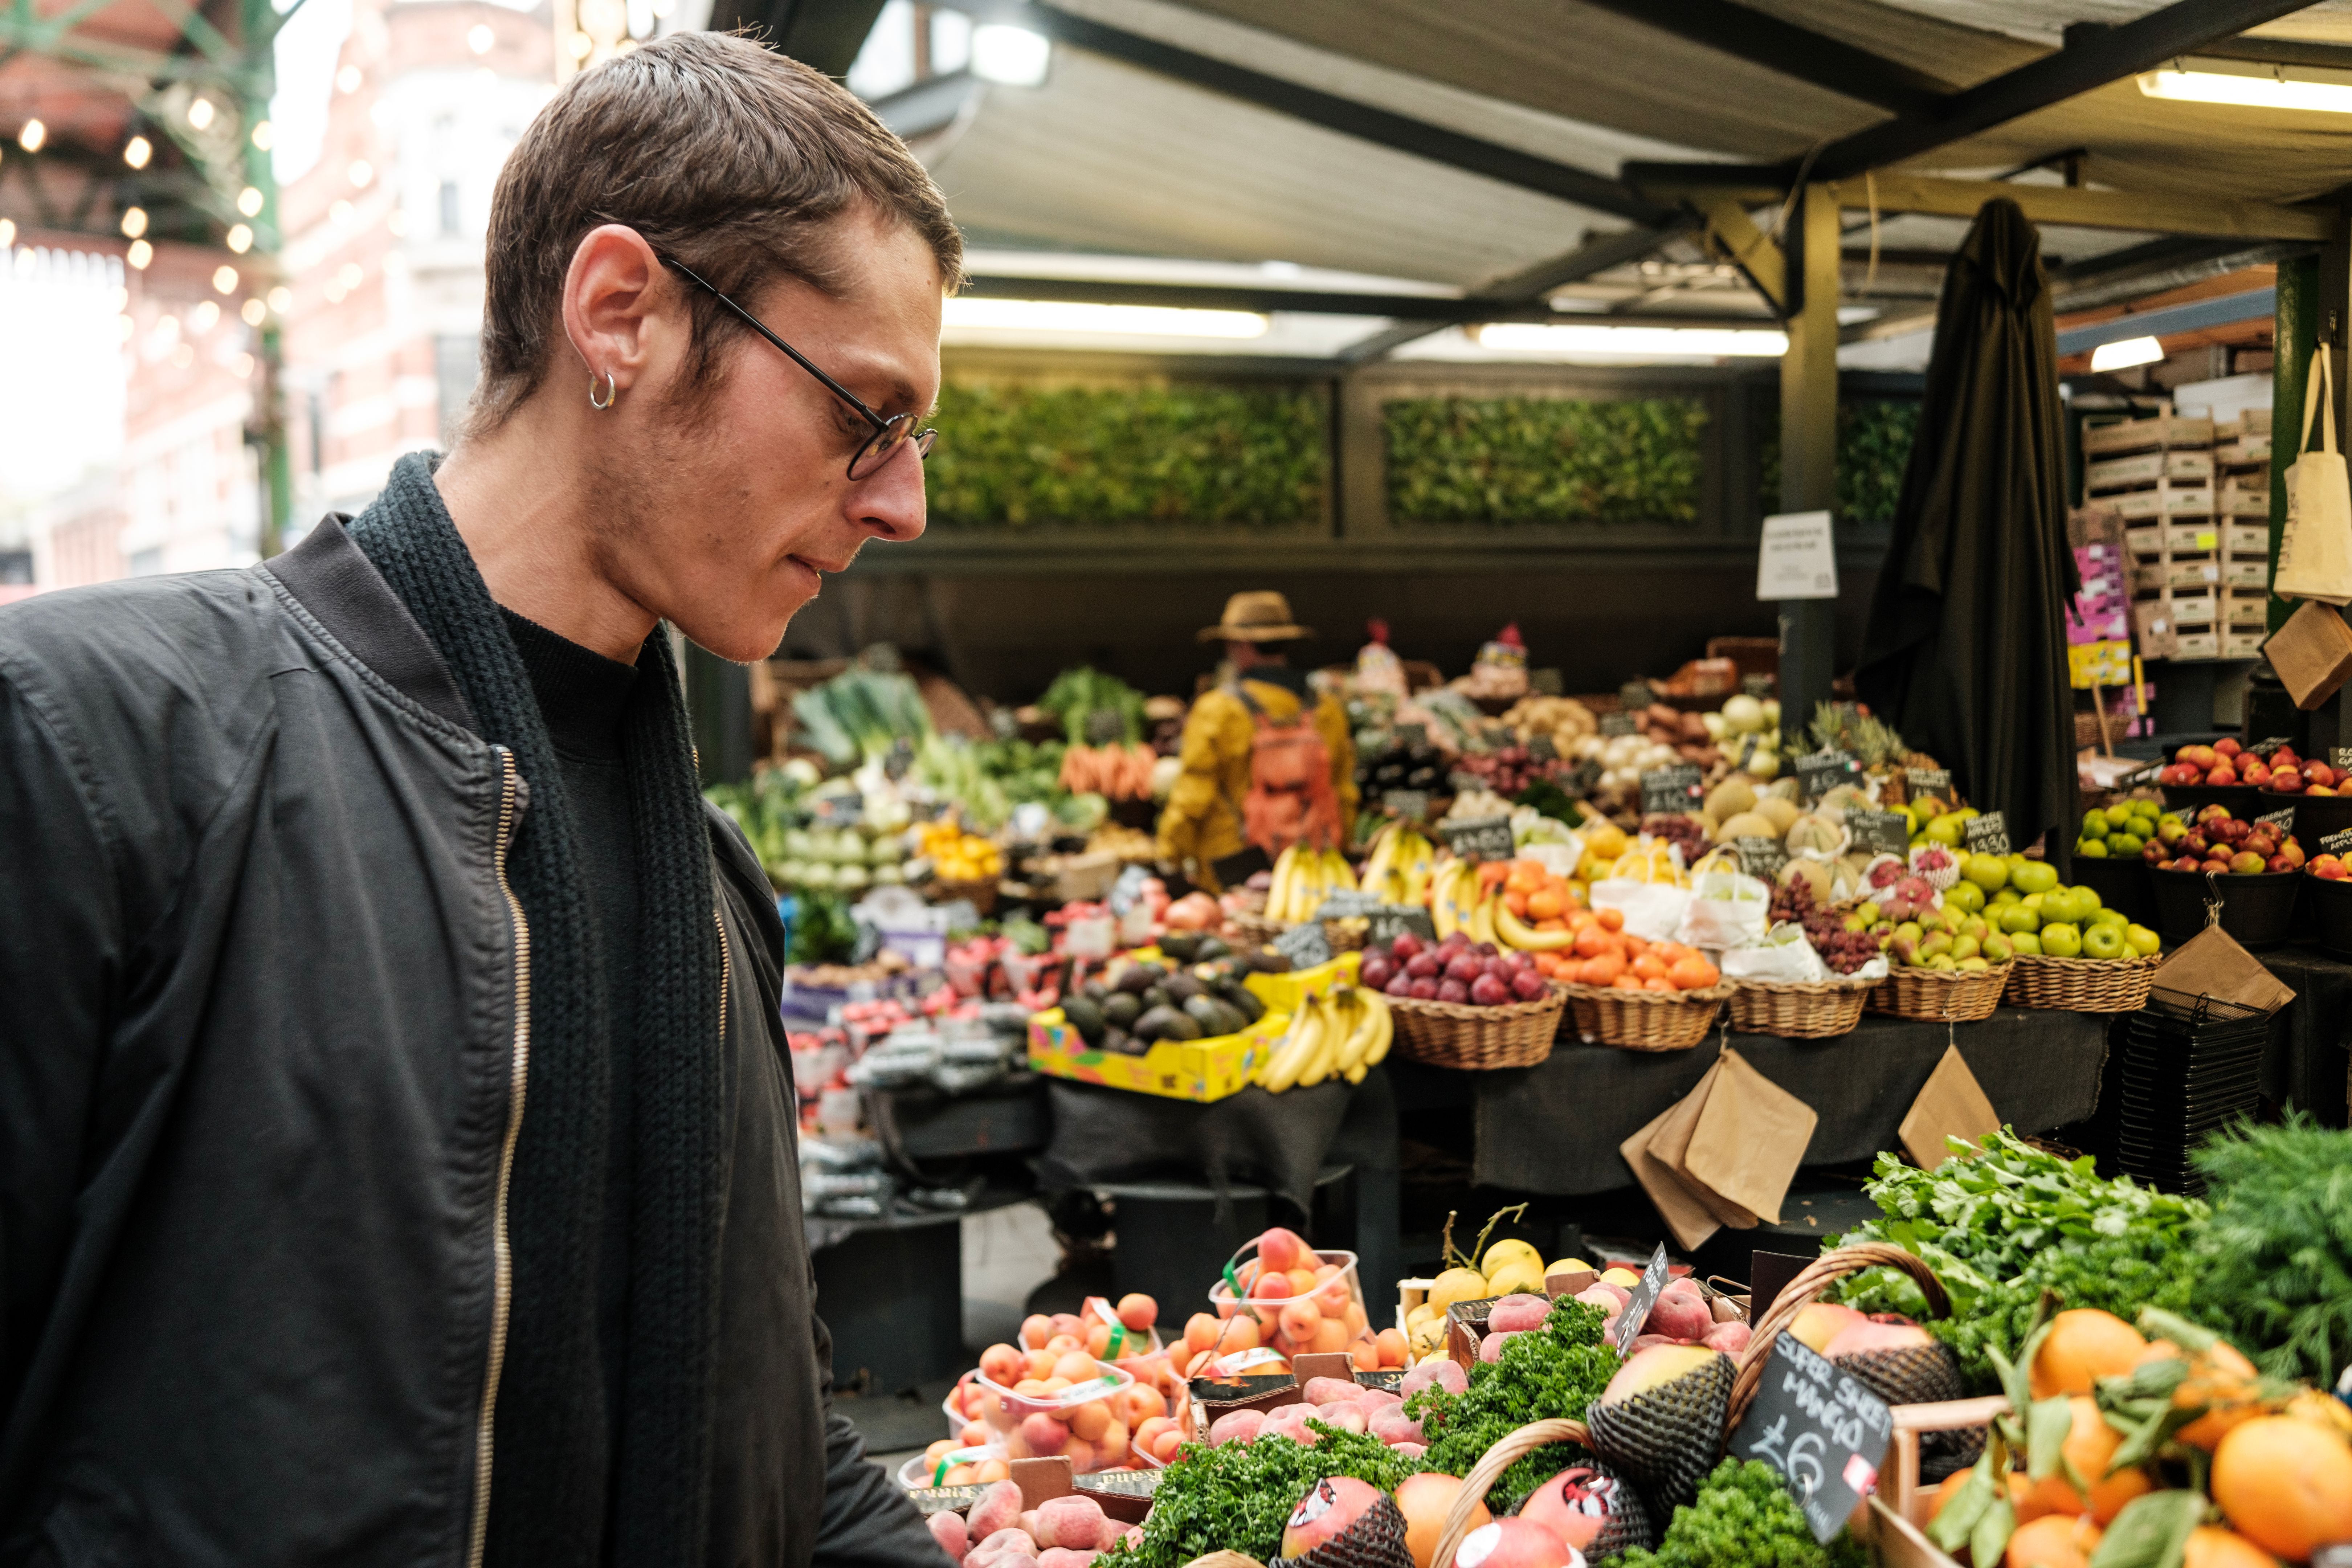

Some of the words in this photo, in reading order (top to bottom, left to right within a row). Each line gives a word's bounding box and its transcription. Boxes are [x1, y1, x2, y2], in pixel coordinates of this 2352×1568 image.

[1776, 1331, 1833, 1391] SUPER
[1834, 1377, 1892, 1441] SWEET
[1783, 1371, 1864, 1451] MANGO
